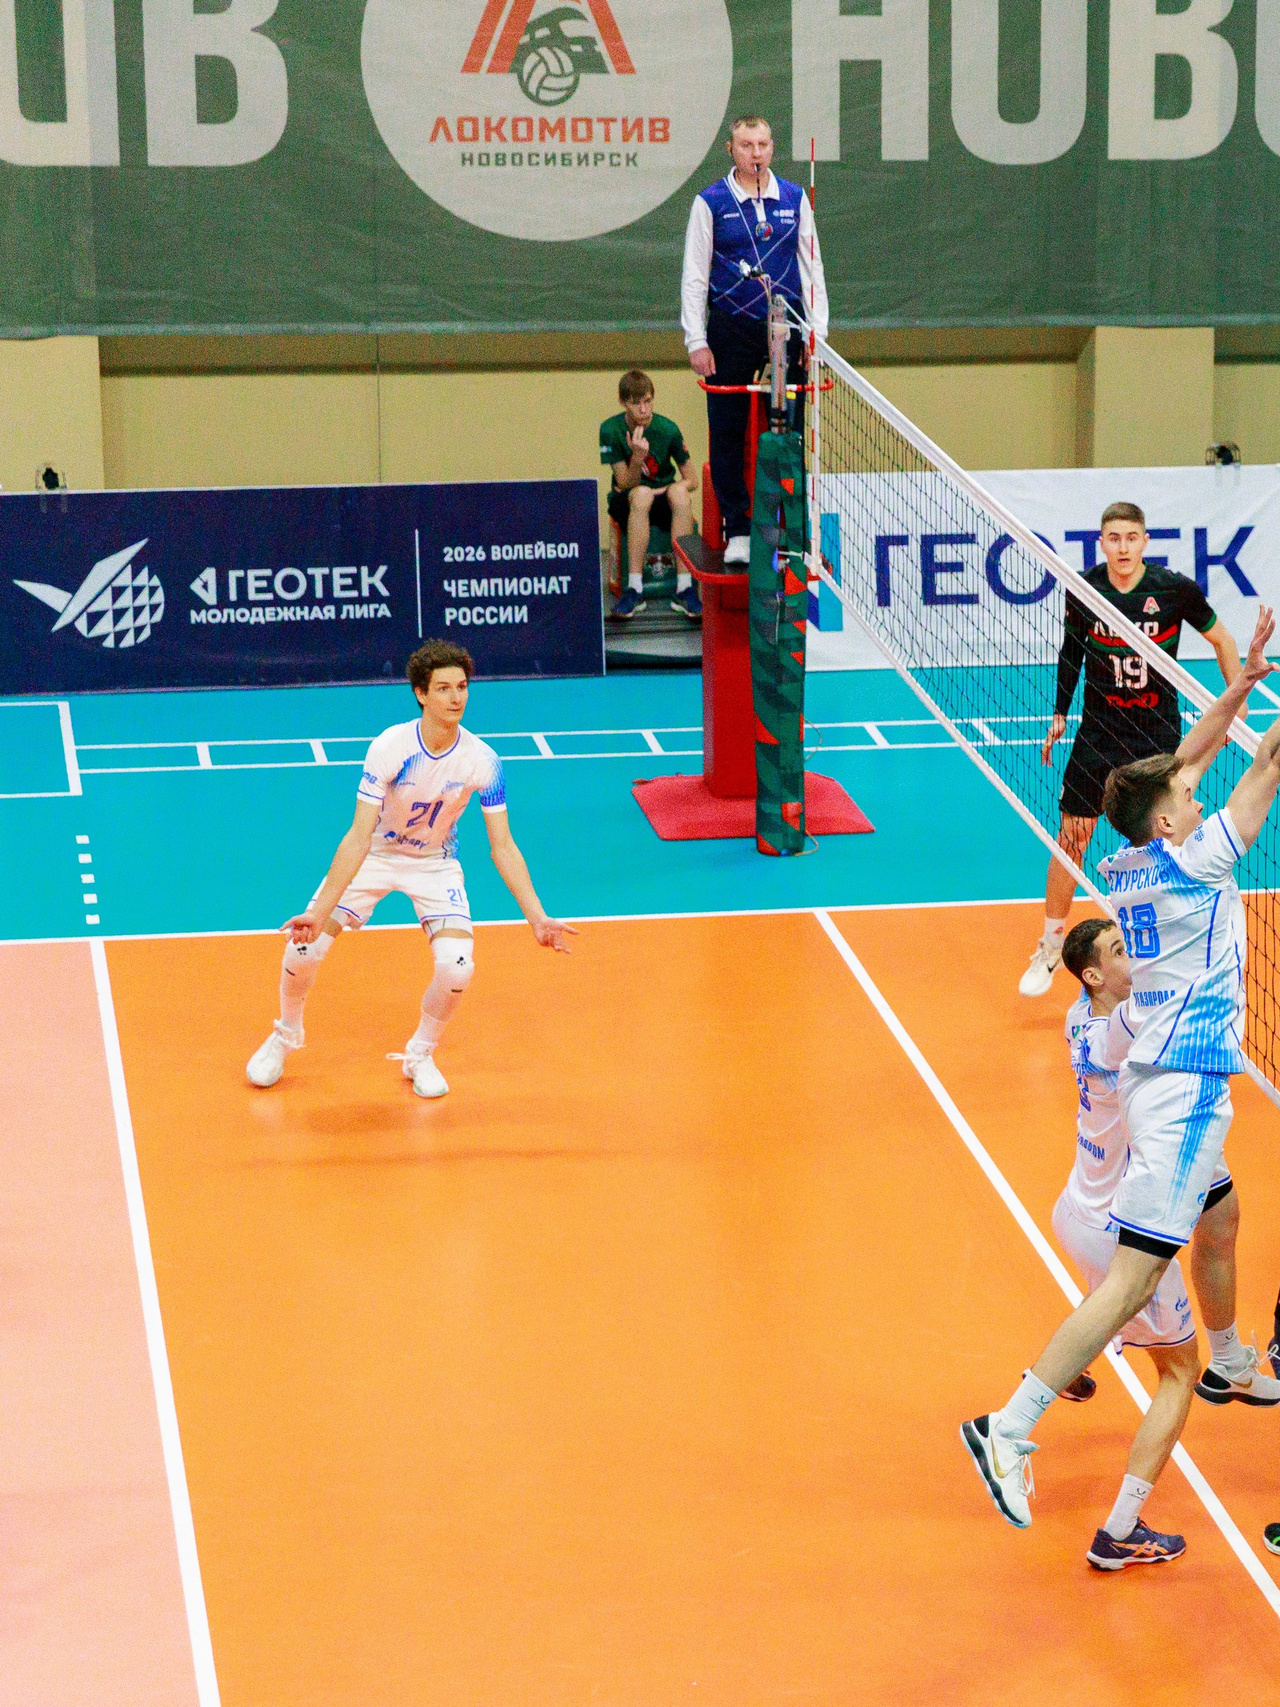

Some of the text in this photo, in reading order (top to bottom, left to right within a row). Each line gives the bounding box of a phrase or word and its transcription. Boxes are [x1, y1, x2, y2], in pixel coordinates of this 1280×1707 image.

[428, 116, 671, 144] ЛОКОМОТИВ
[460, 152, 639, 168] НОВОСИБИРСК
[443, 541, 579, 563] 2026 ВОЛЕЙБОЛ
[228, 564, 390, 602] ГЕОТЕК
[443, 575, 572, 598] ЧЕМПИОНАТ
[190, 603, 392, 624] МОЛОДЕЖНАЯ ЛИГА
[444, 606, 528, 626] РОССИИ
[1108, 654, 1149, 689] 19
[406, 800, 444, 829] 21
[1105, 863, 1171, 893] ЕКУРСКОВ
[447, 888, 463, 902] 21
[1117, 902, 1161, 959] 18
